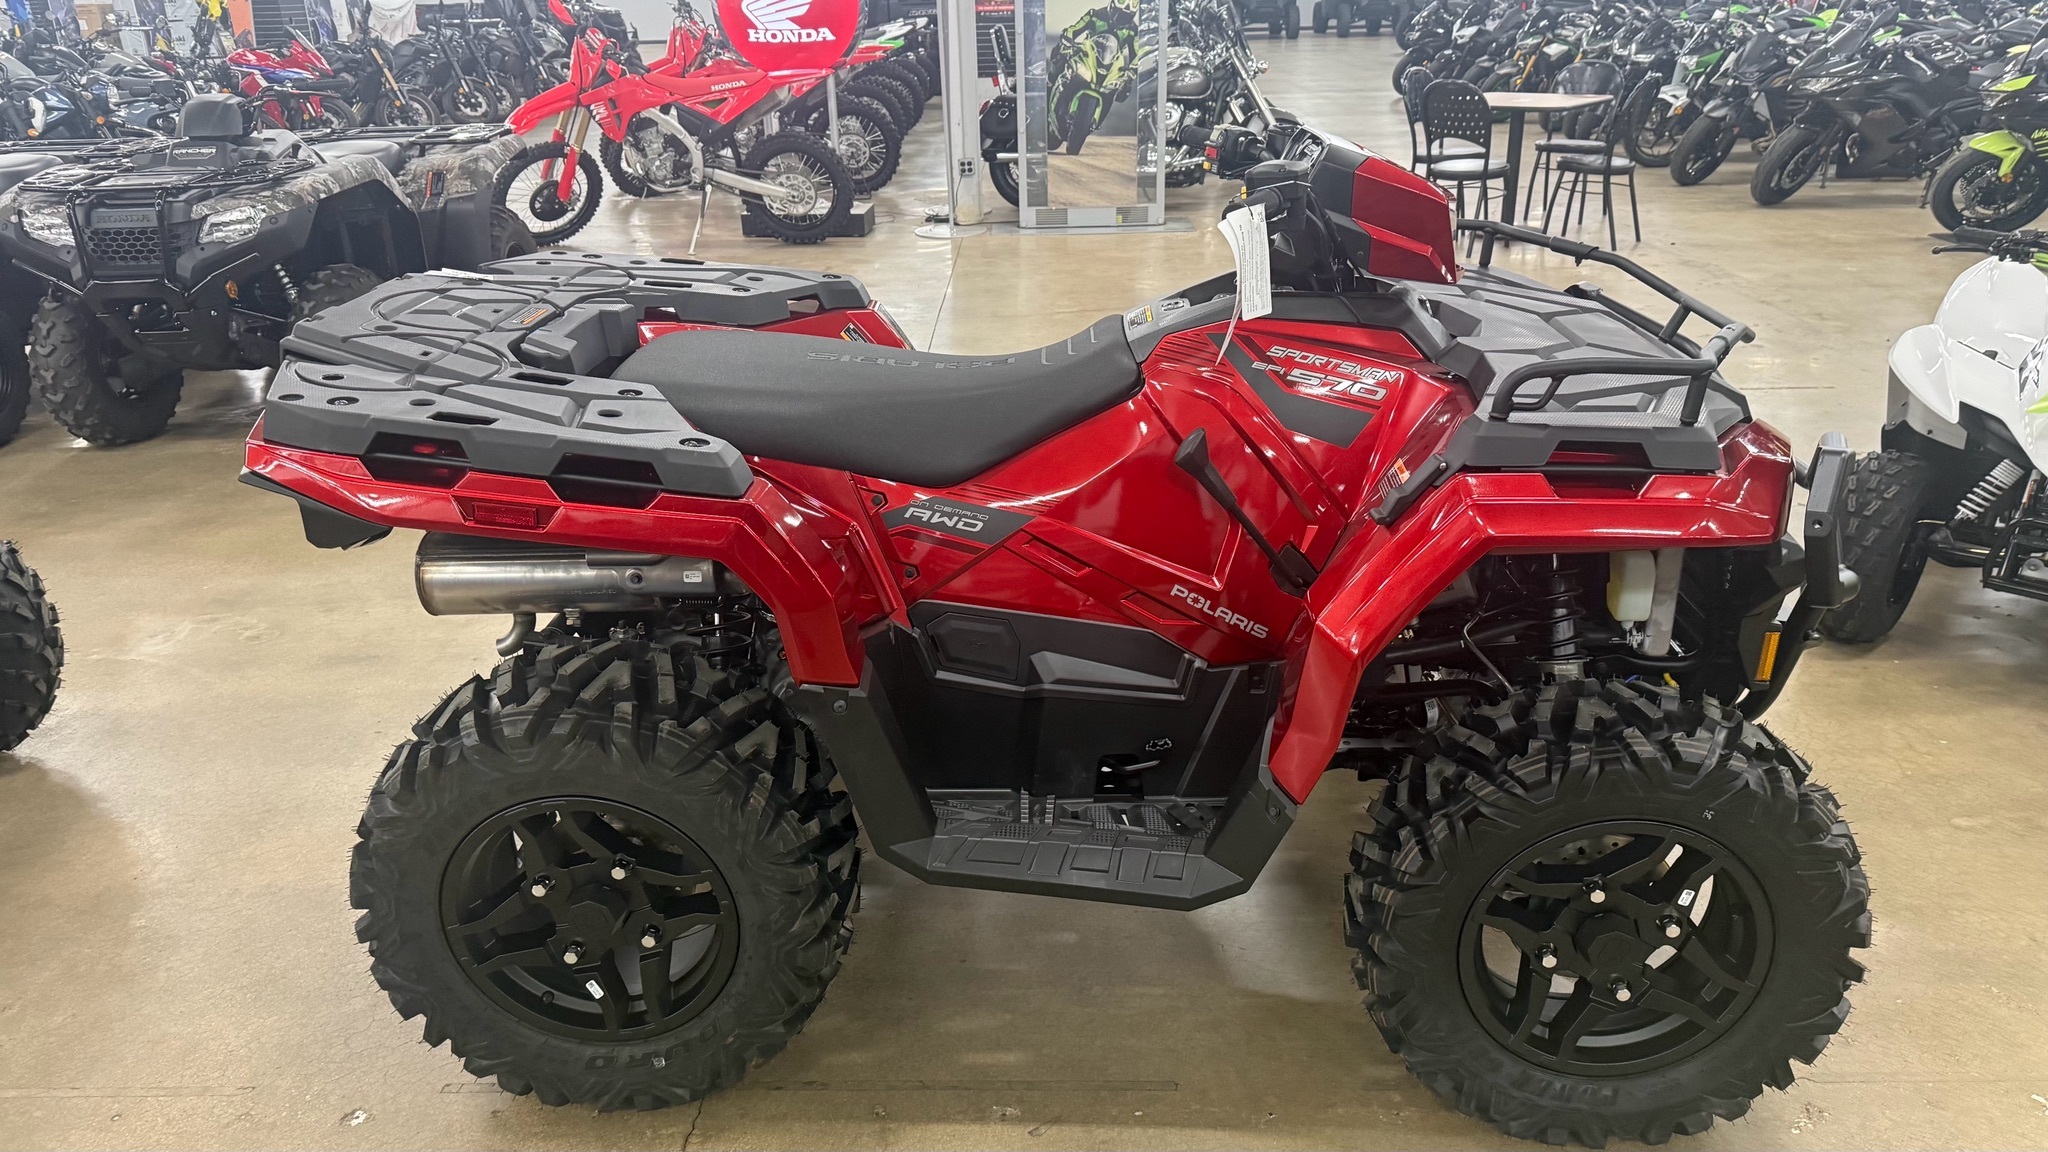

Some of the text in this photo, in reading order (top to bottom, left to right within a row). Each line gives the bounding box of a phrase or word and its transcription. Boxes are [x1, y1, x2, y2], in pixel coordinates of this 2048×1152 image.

[747, 27, 836, 43] HONDA
[710, 79, 747, 92] HONDA
[173, 145, 217, 155] RANCHER
[97, 214, 151, 224] HONDA
[1266, 345, 1402, 384] SPORTSMAN
[1287, 367, 1389, 401] 570
[903, 506, 985, 533] AWD
[910, 499, 990, 521] ON DEMAND
[1169, 583, 1270, 640] POLARIS
